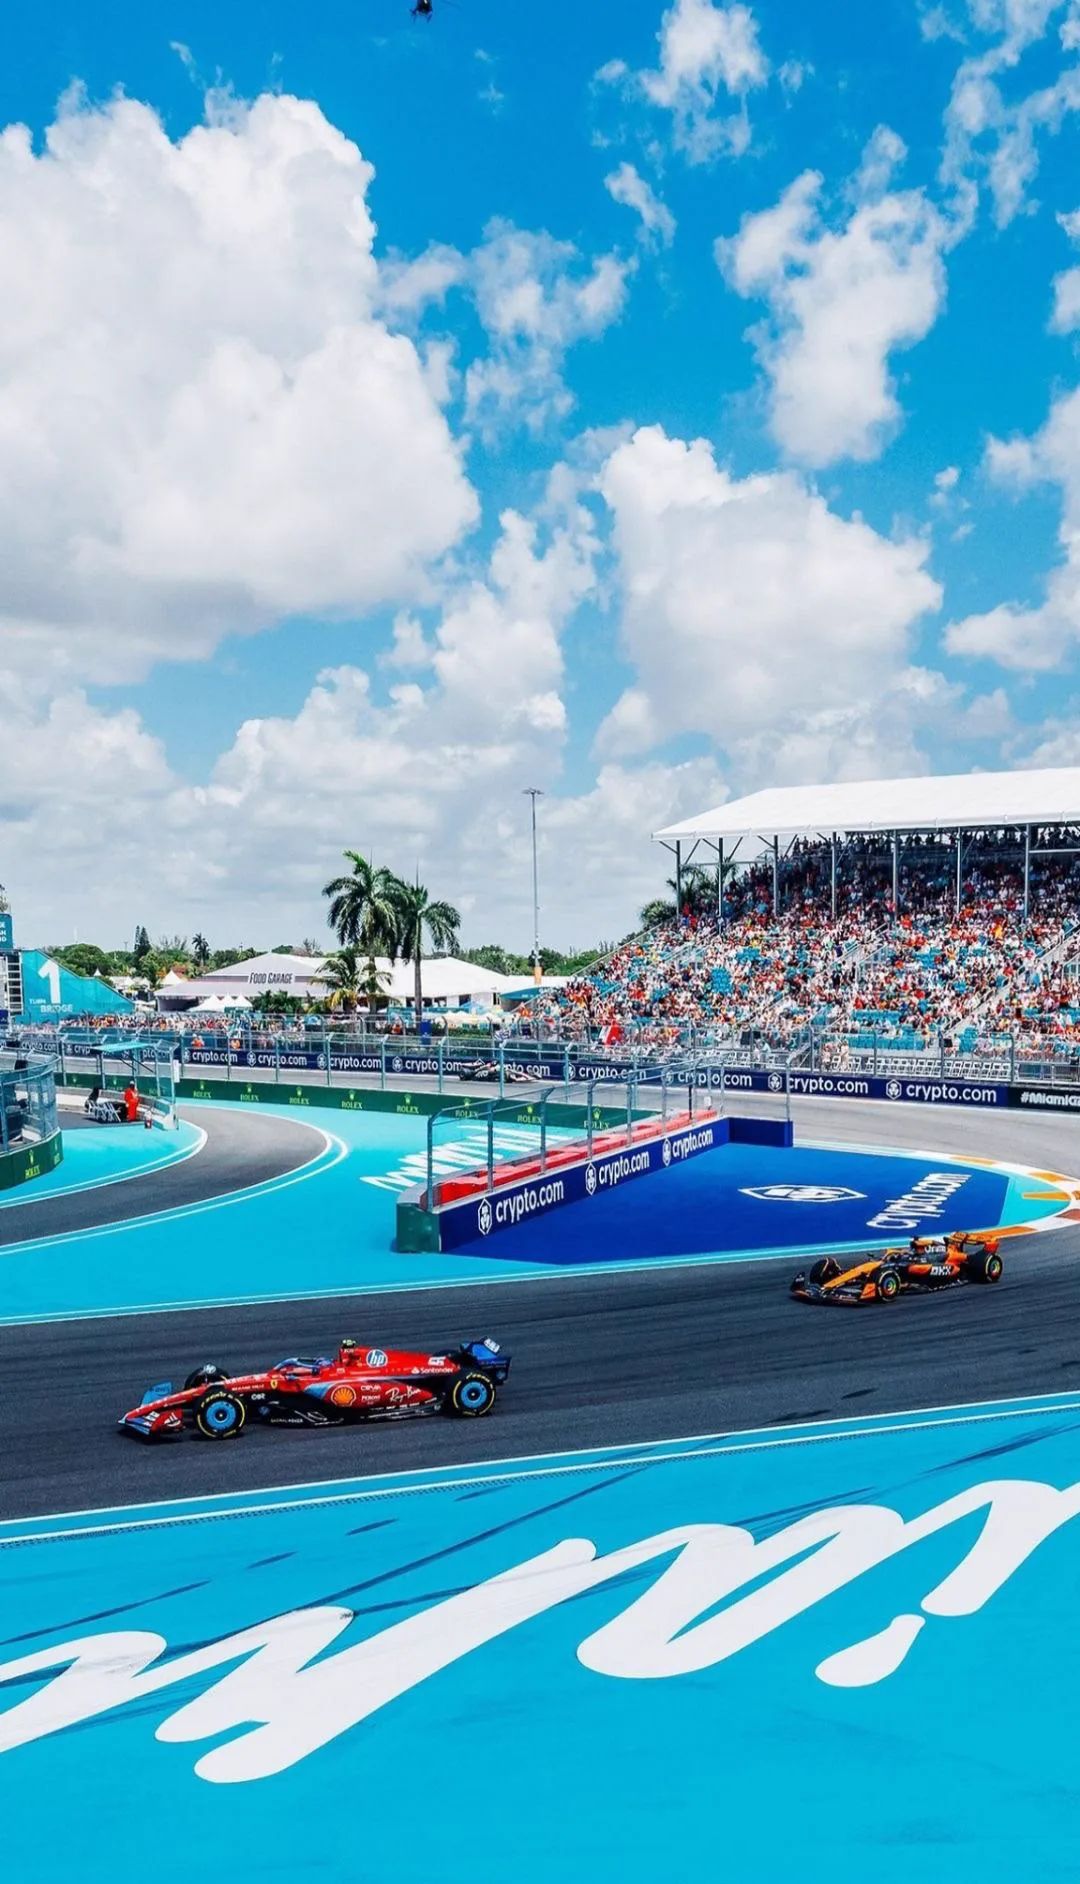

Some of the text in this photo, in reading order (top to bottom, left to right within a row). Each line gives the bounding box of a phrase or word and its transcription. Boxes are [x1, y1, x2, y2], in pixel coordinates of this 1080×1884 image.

[38, 959, 61, 1004] 1
[250, 972, 293, 984] FOOD GARAGE
[330, 1056, 382, 1070] crypto.com
[405, 1059, 462, 1073] cryptocom
[678, 1072, 752, 1088] crypocom
[788, 1076, 869, 1095] crypto.com
[906, 1084, 997, 1103] crypto.com
[341, 1101, 362, 1109] ROLEX
[396, 1105, 419, 1114] ROLEX
[583, 1120, 609, 1129] RLEX
[671, 1128, 713, 1159] crypto.com
[599, 1150, 649, 1185] crypto.com
[495, 1180, 564, 1223] crypto.com
[385, 1384, 421, 1403] Ray-Ban
